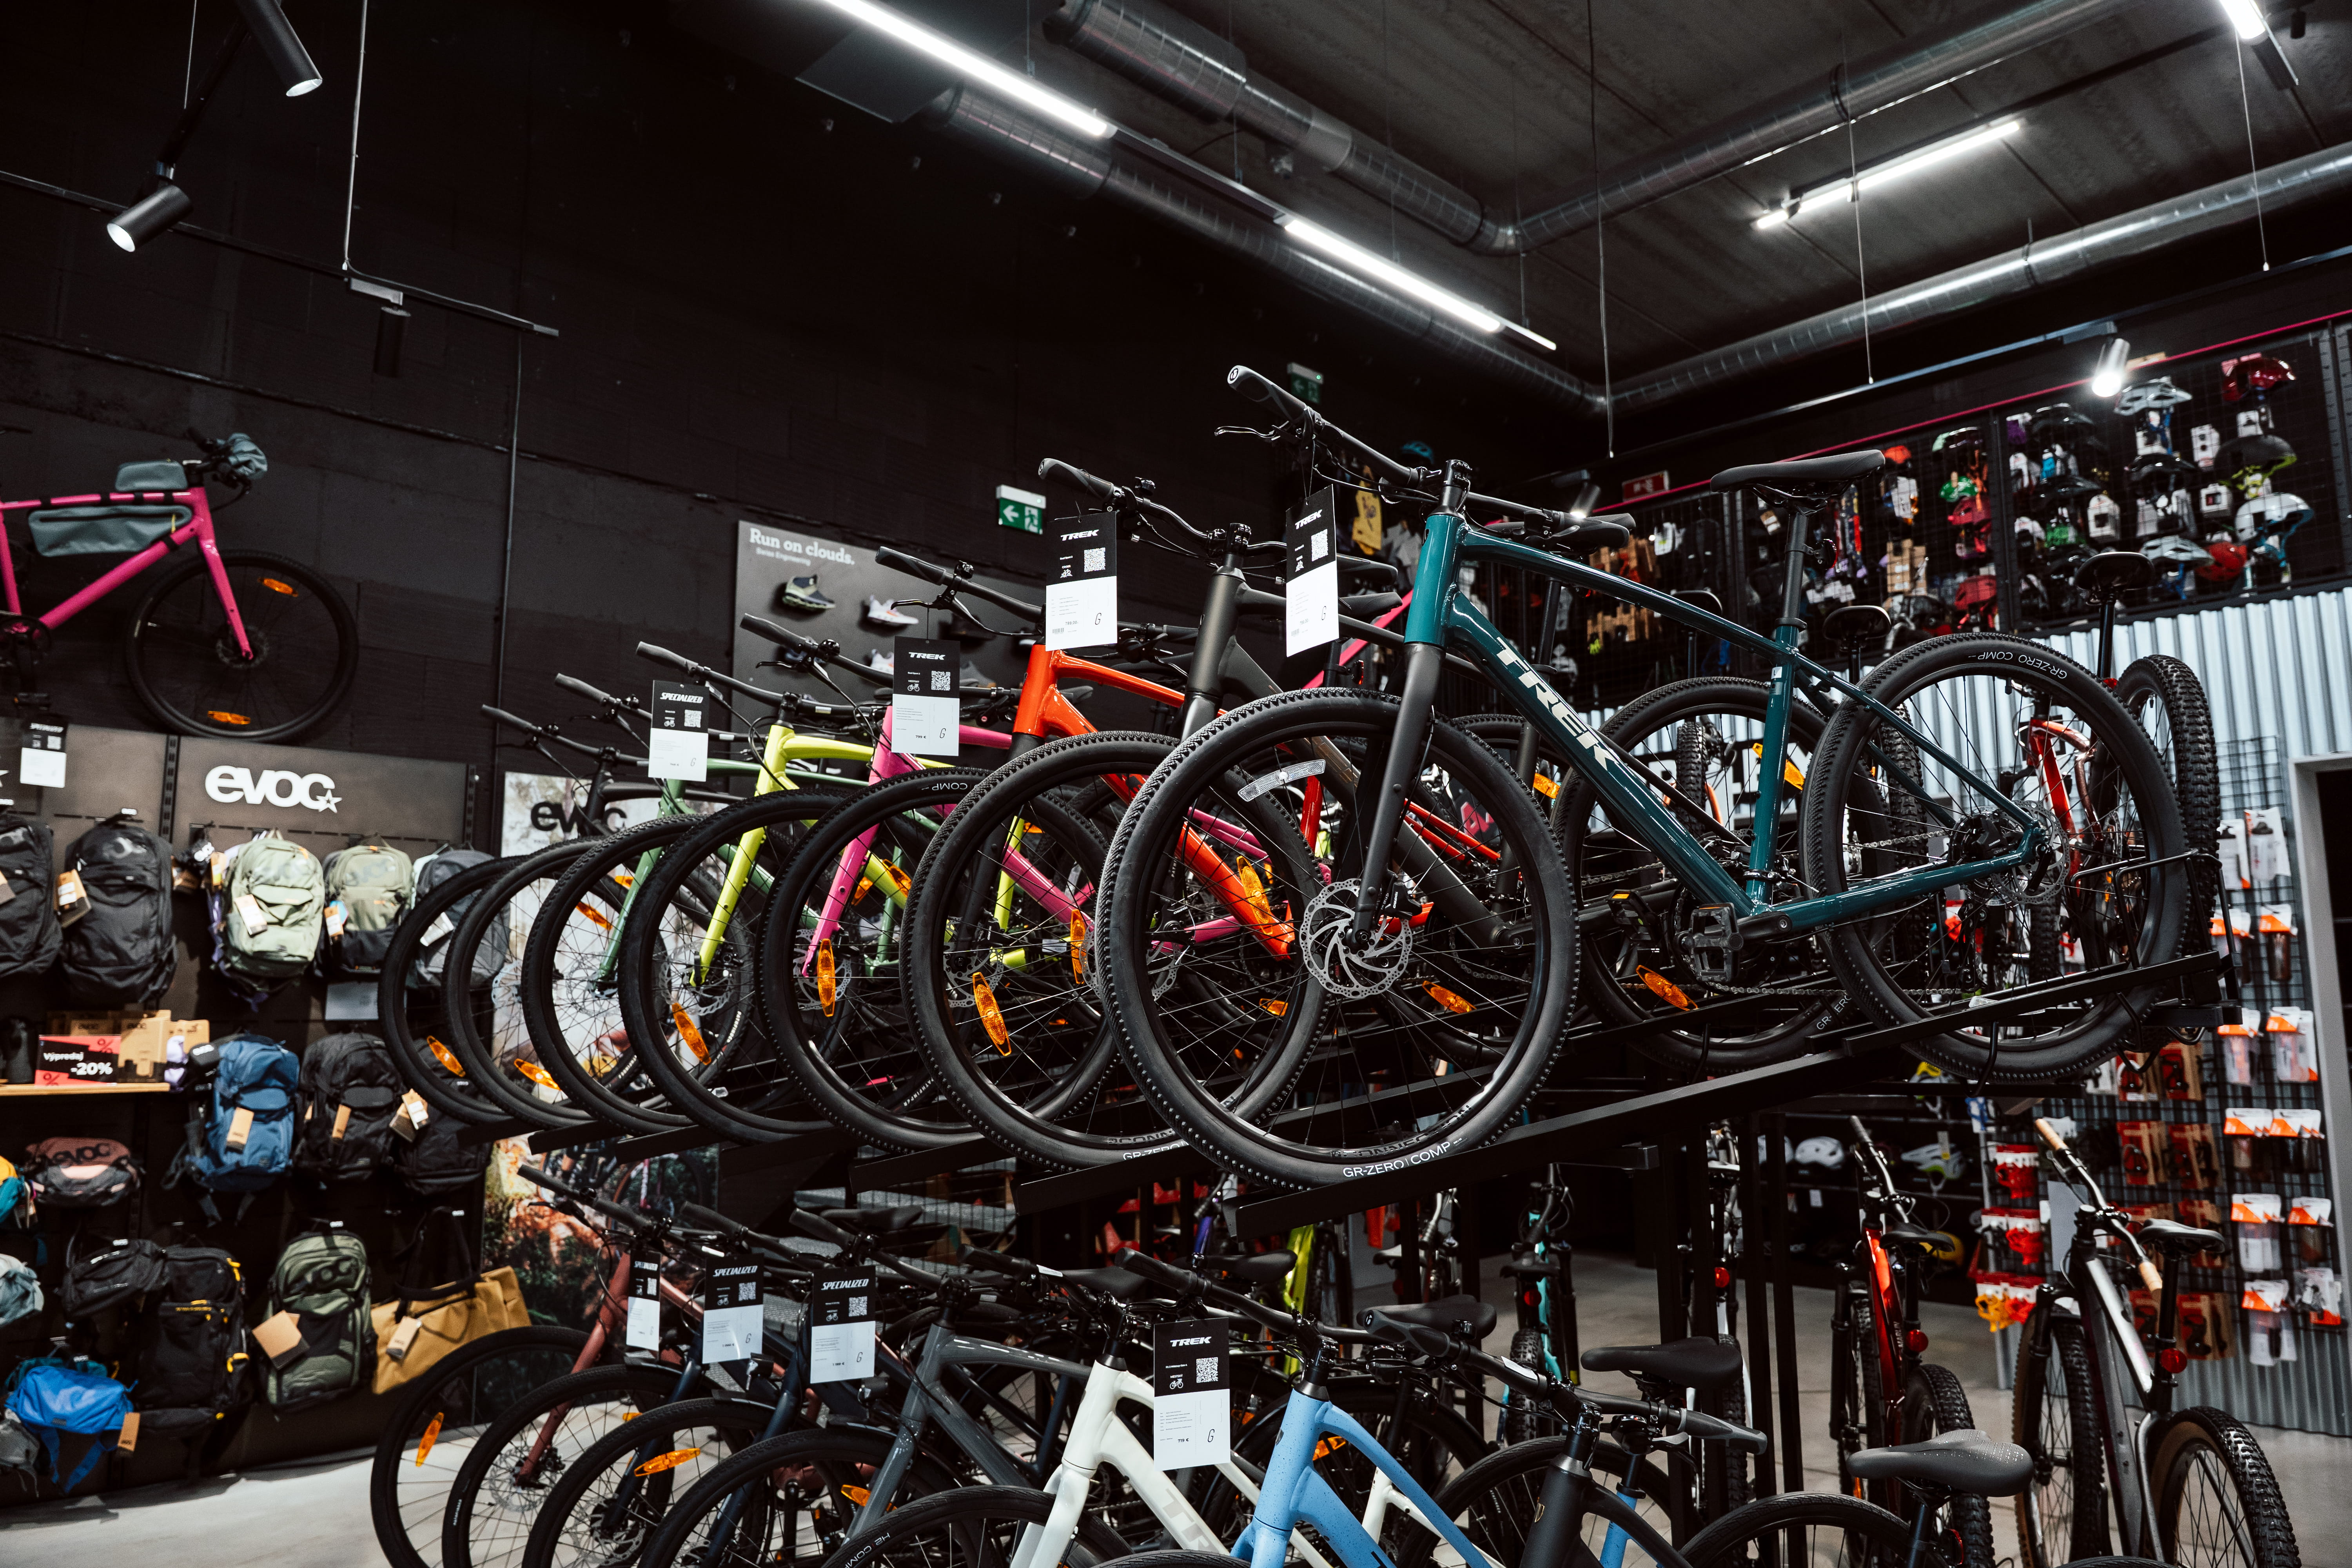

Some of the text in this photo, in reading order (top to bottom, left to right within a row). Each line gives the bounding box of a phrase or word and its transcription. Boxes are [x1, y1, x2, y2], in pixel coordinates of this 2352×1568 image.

[1295, 510, 1322, 530] TREK
[1060, 530, 1099, 541] TREK
[750, 527, 855, 565] Run on clouds.
[1095, 613, 1102, 625] G
[908, 652, 946, 660] TREK
[1978, 652, 2067, 679] GR-ZERO COMP
[660, 692, 704, 703] SPECIALIZED
[1497, 637, 1619, 770] TREK
[940, 728, 946, 739] G
[932, 782, 967, 791] COMP
[531, 801, 627, 834] evc
[1817, 995, 1852, 1030] GR-ERO
[43, 1051, 84, 1062] Výpredaj
[70, 1062, 113, 1076] -20%
[1343, 1141, 1451, 1178] GR-ZERO COMP
[712, 1265, 758, 1277] SPECIALIZED
[821, 1279, 869, 1290] SPECIALIZED
[1170, 1336, 1212, 1347] TREK
[1208, 1429, 1215, 1443] G
